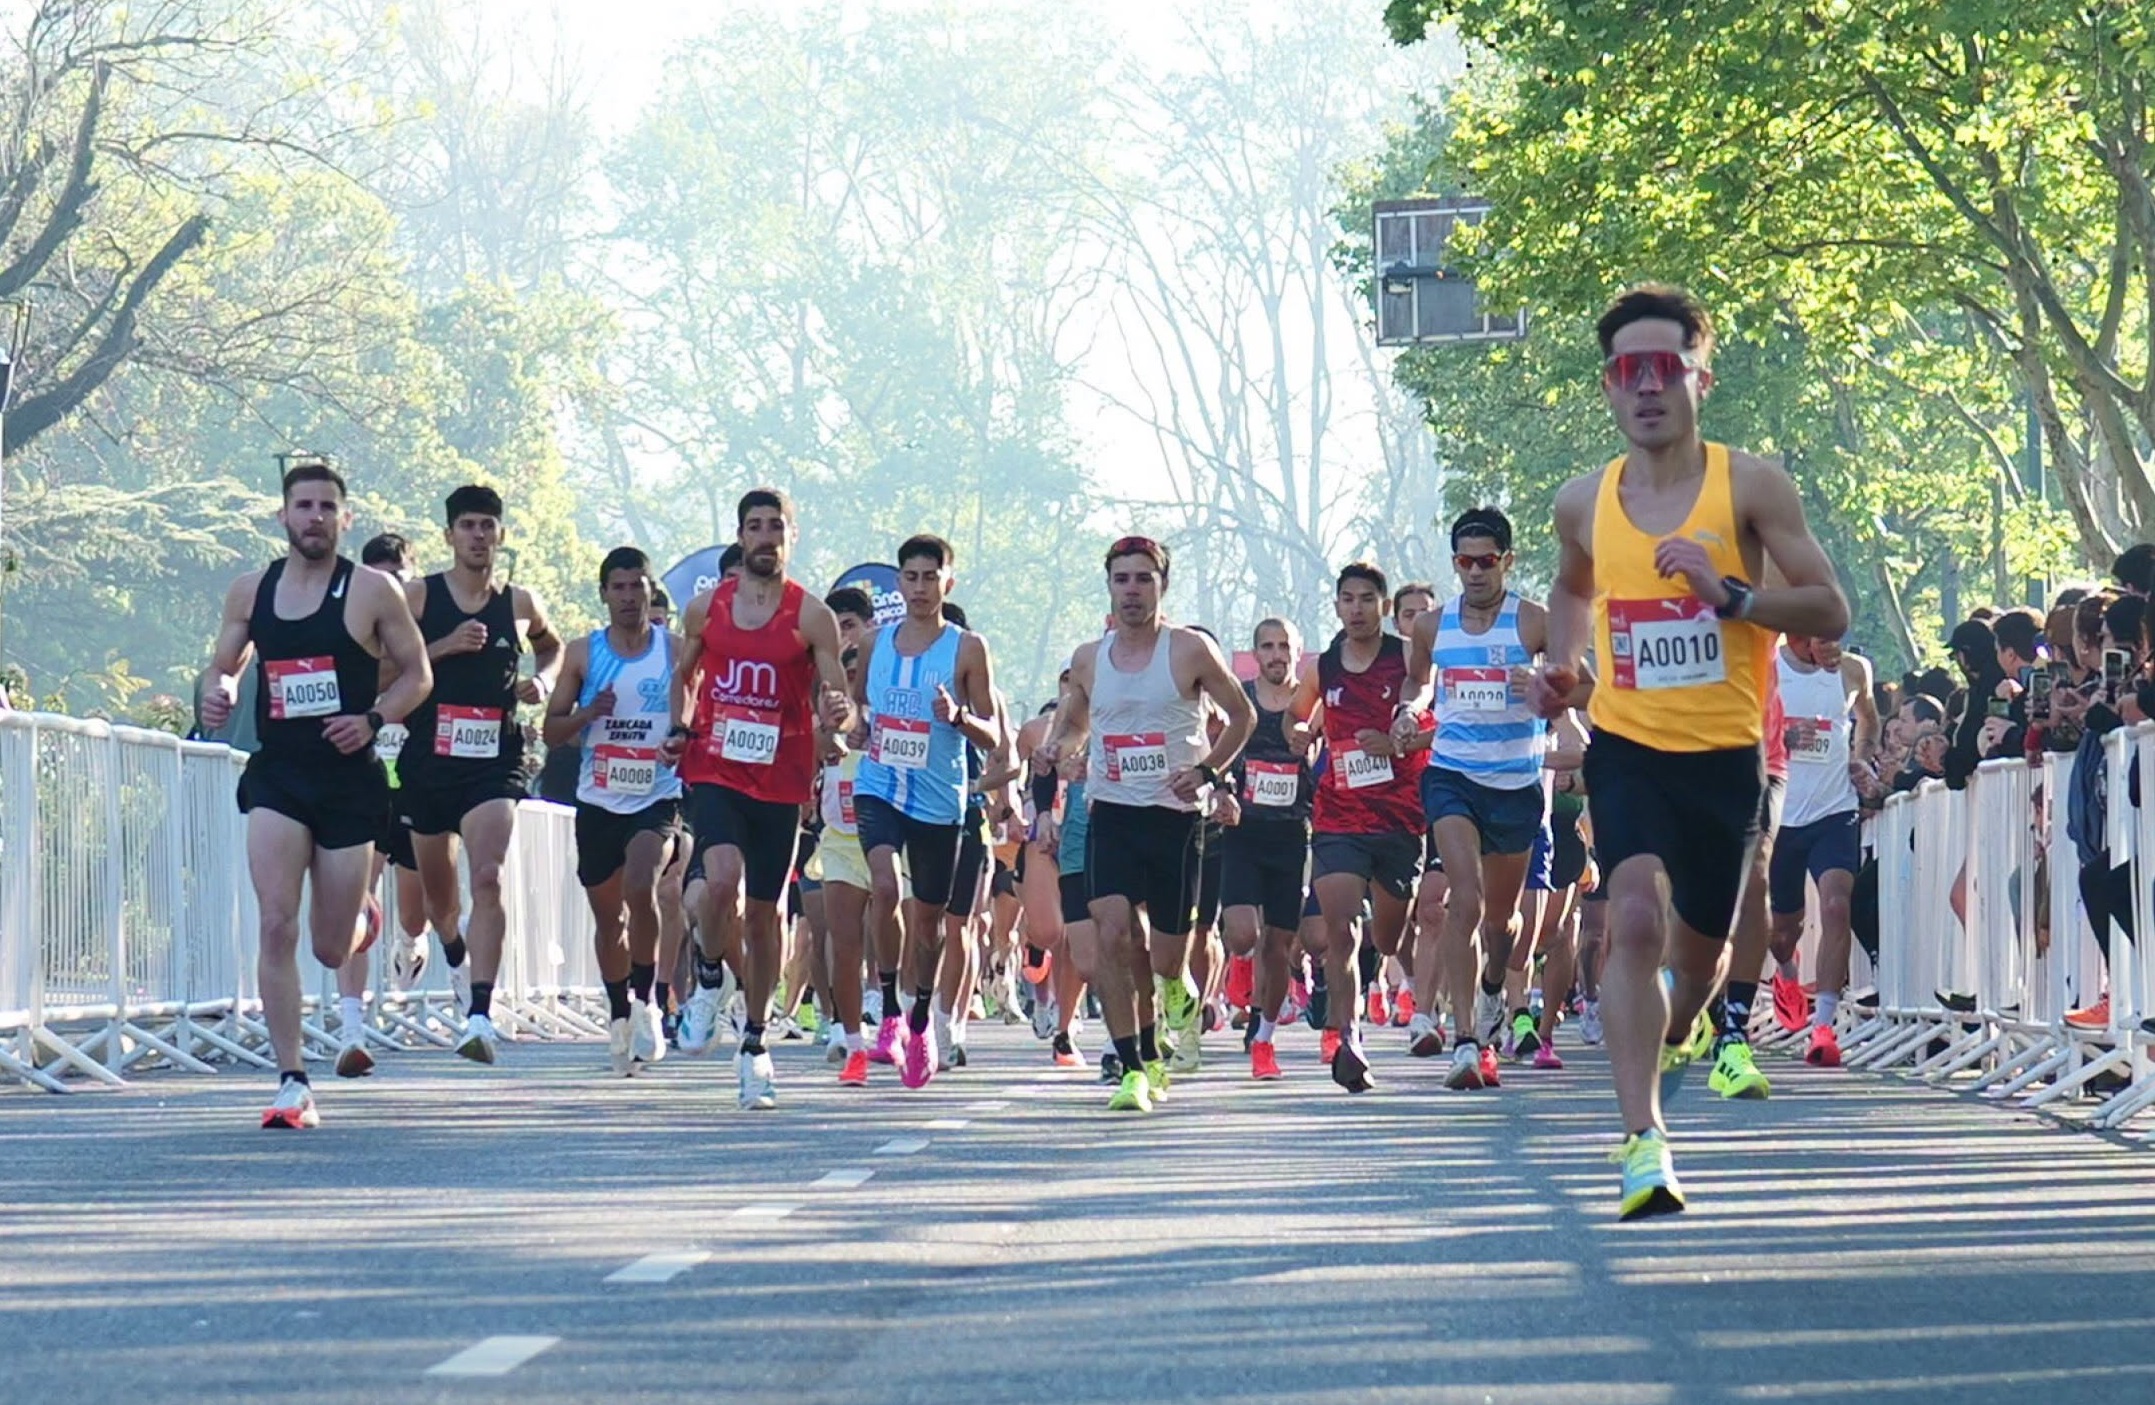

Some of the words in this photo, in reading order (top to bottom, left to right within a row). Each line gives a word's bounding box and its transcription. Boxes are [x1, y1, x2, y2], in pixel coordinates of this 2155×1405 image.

[1639, 632, 1718, 668] A0010
[287, 682, 337, 705] A0050
[710, 687, 779, 708] Corredores
[604, 720, 652, 730] ZANCADA
[454, 727, 497, 745] A0024
[727, 729, 776, 753] A0030
[883, 736, 926, 758] A0039
[1122, 754, 1166, 772] A0038
[1349, 755, 1388, 776] A0040
[610, 767, 653, 784] A0008
[1257, 780, 1295, 797] A0001
